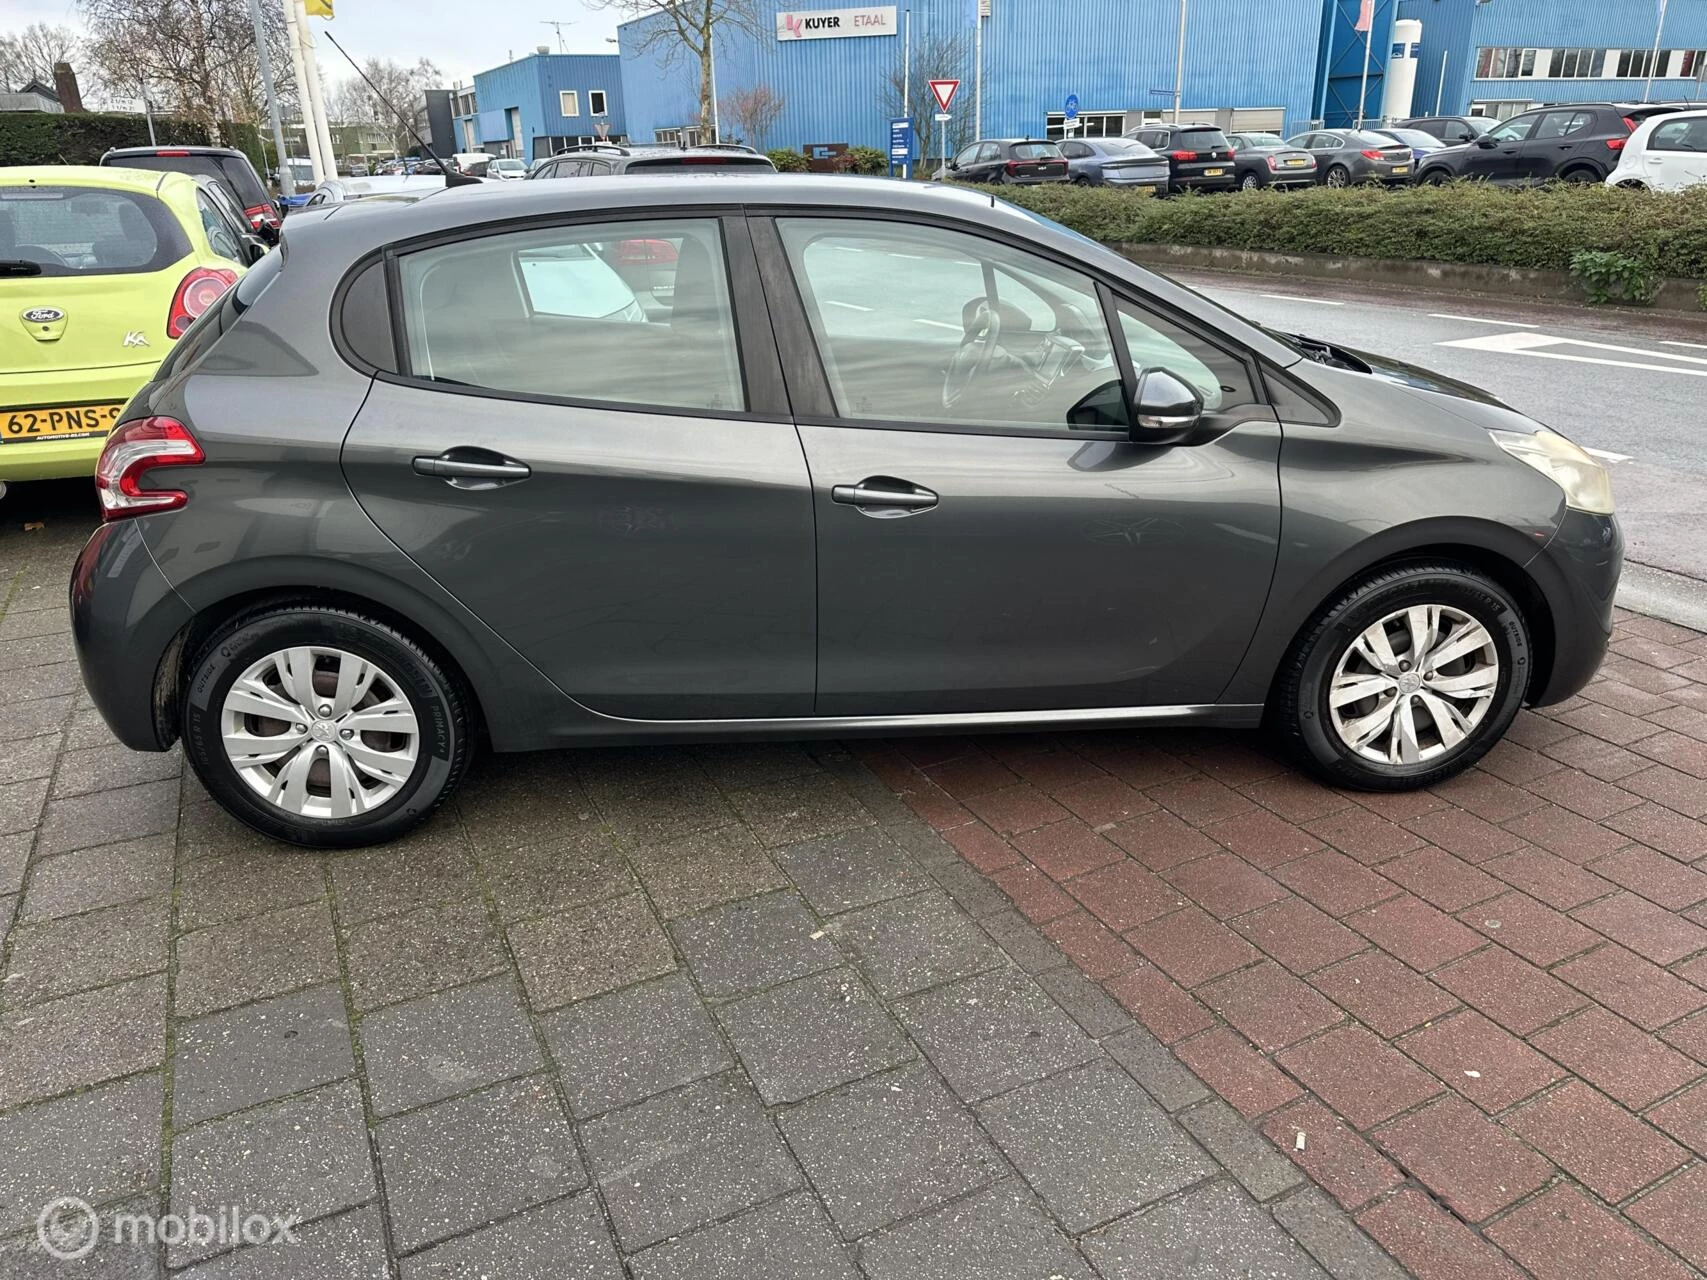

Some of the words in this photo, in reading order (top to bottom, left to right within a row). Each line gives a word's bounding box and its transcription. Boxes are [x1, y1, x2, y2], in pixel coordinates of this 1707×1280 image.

[805, 17, 840, 29] KUYER
[31, 309, 55, 319] Ford
[122, 331, 150, 347] Ka
[431, 705, 446, 748] PRIMACY
